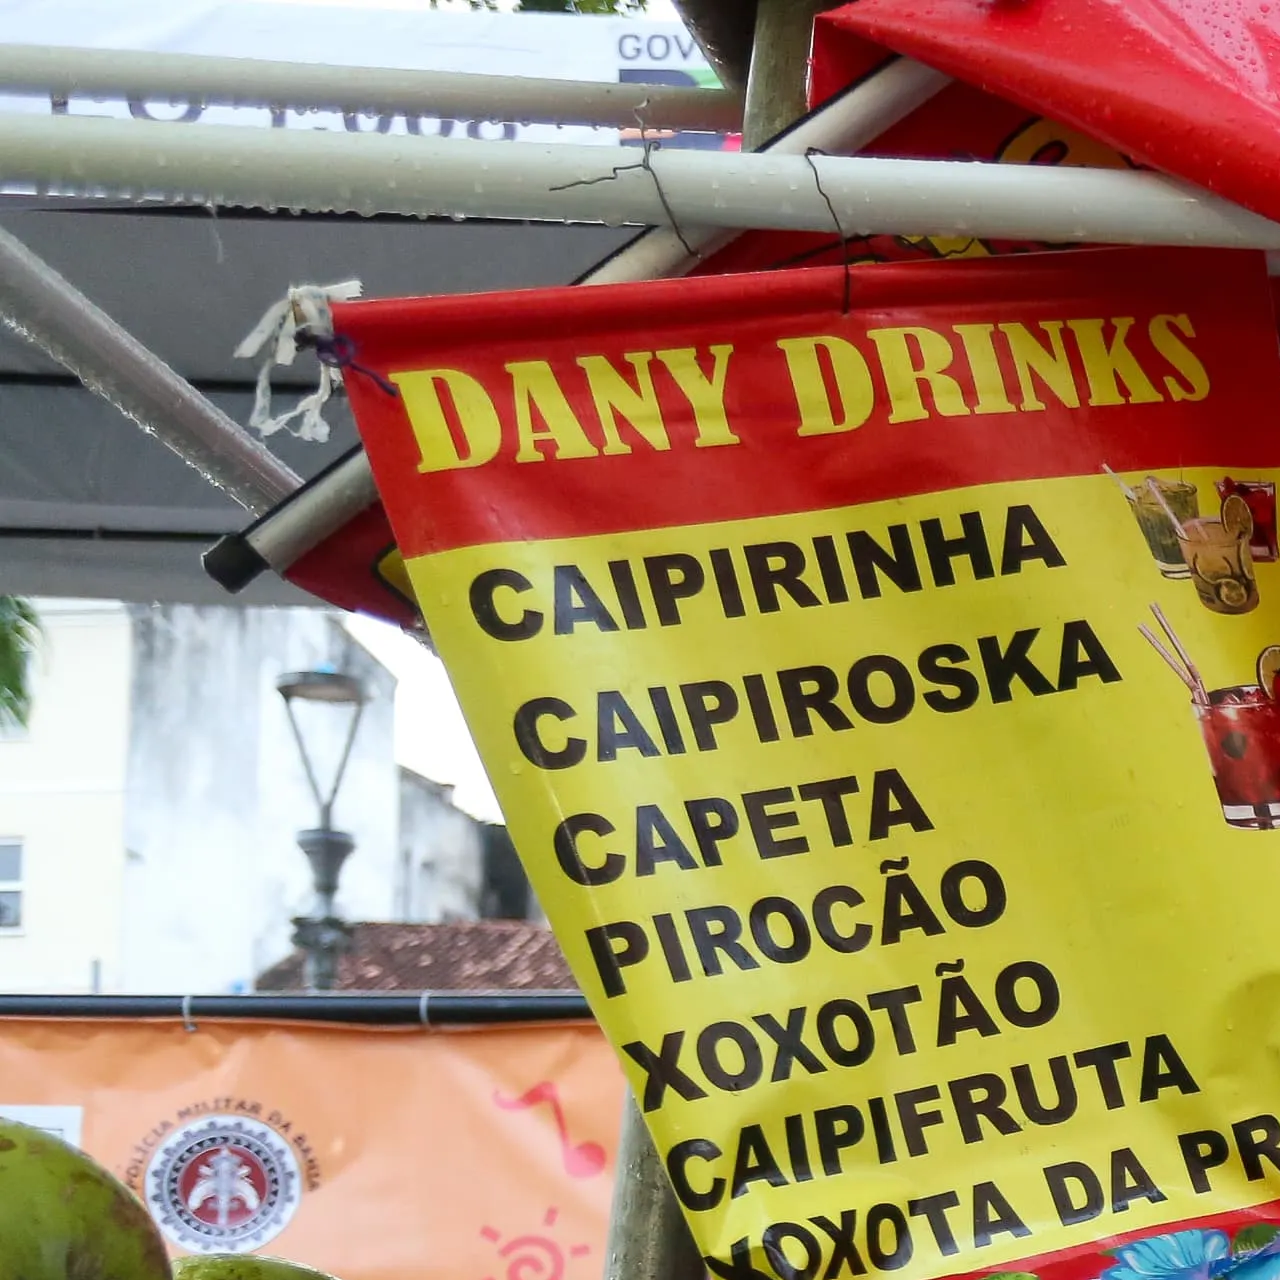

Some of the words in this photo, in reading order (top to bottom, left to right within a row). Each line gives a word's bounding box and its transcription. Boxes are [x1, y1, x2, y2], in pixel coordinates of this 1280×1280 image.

[390, 344, 739, 473] DANY
[776, 313, 1210, 437] DRINKS
[470, 505, 1065, 642] CAIPIRINHA
[513, 619, 1122, 771] CAIPIROSKA
[553, 768, 934, 887] CAPETA
[583, 857, 1008, 999] PIROCÃO
[622, 958, 1061, 1113] XOXOTÃO
[177, 1098, 262, 1120] MILITAR
[293, 1133, 321, 1192] BAHIA
[666, 1033, 1199, 1213] CAIPIFRUTA
[1043, 1147, 1168, 1227] DA
